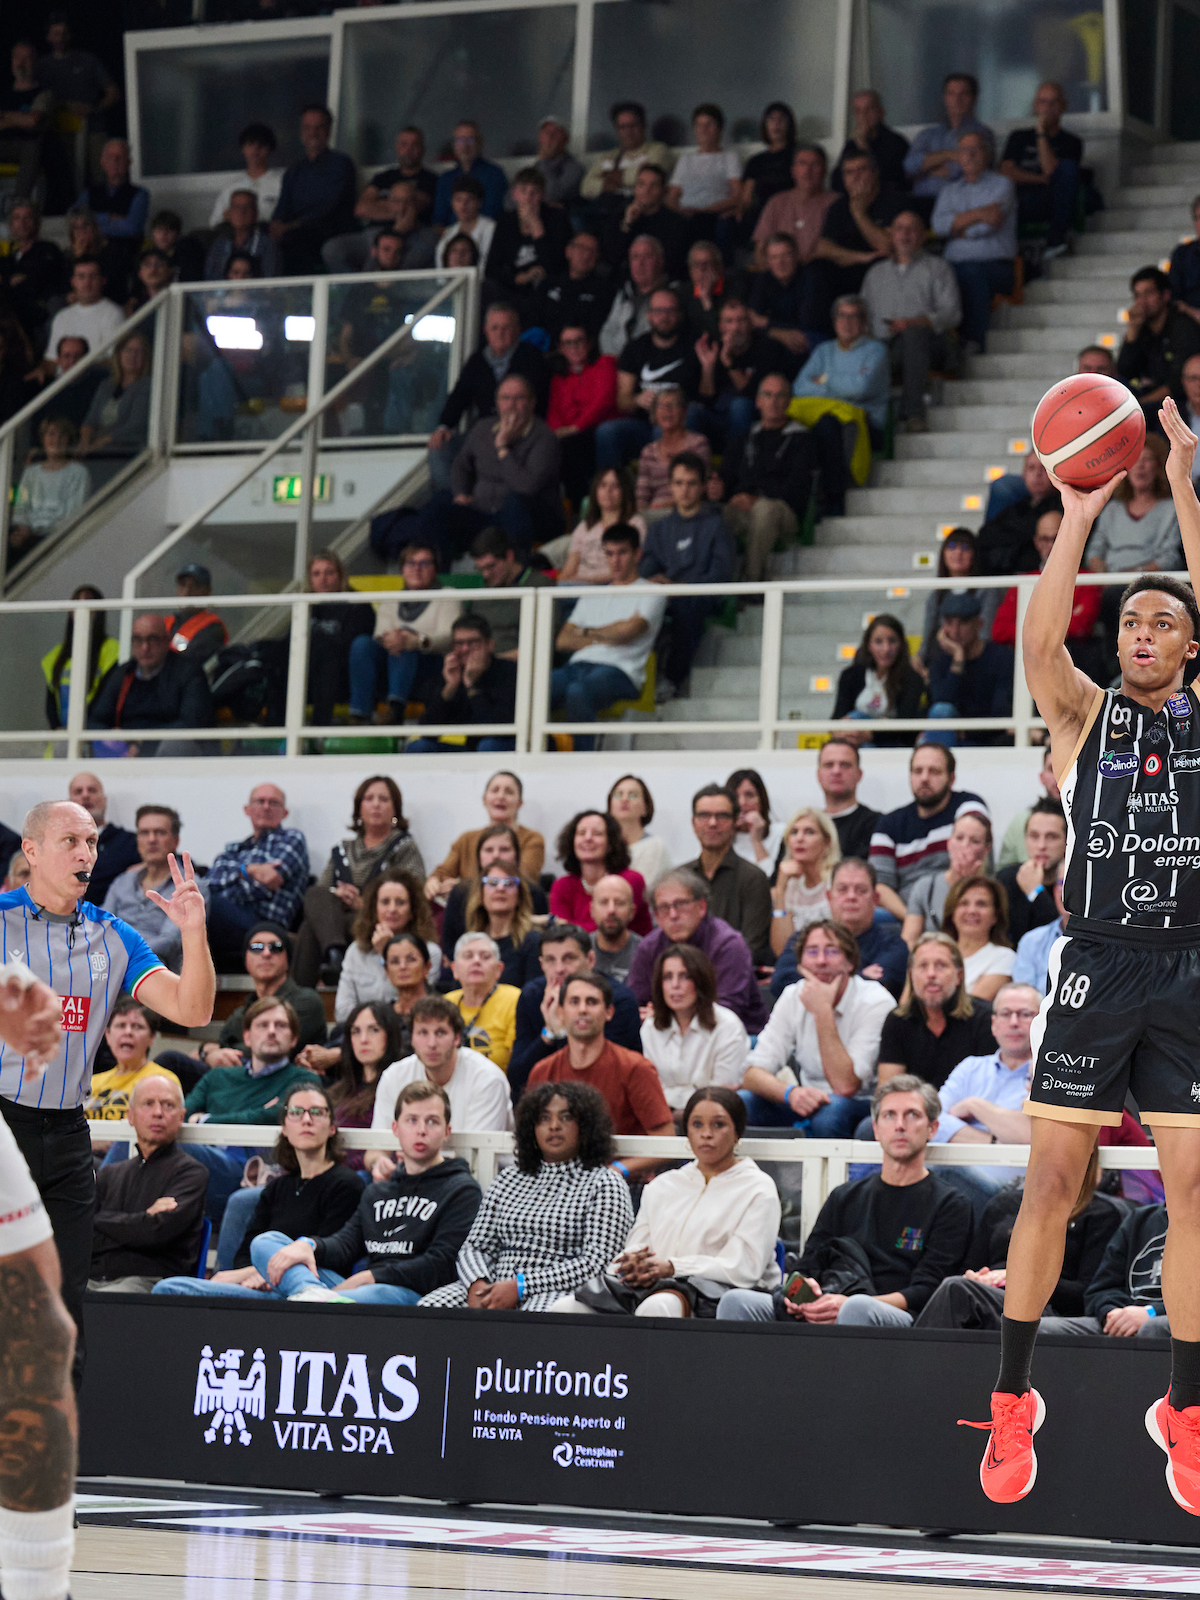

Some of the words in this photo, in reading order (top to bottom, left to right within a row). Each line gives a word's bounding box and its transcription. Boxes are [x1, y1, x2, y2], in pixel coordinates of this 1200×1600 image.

[1100, 757, 1138, 772] Melinda
[1144, 791, 1180, 805] ITAS
[1145, 804, 1174, 813] MUTUA
[92, 973, 108, 982] FIP
[1059, 972, 1091, 1010] 68
[1044, 1051, 1100, 1069] CAVIT
[1053, 1079, 1096, 1093] Dolomiti
[1065, 1090, 1094, 1099] energia
[275, 1350, 420, 1422] ITAS
[475, 1358, 629, 1400] plurifonds
[484, 1409, 518, 1425] Fondo
[519, 1411, 571, 1428] Pensione
[572, 1414, 612, 1431] Aperto
[614, 1416, 626, 1430] di
[272, 1420, 334, 1451] VITA
[341, 1424, 395, 1454] SPA
[472, 1426, 497, 1440] ITAS
[498, 1427, 523, 1441] VITA
[575, 1444, 618, 1458] Pensplan
[574, 1456, 616, 1469] Centrum
